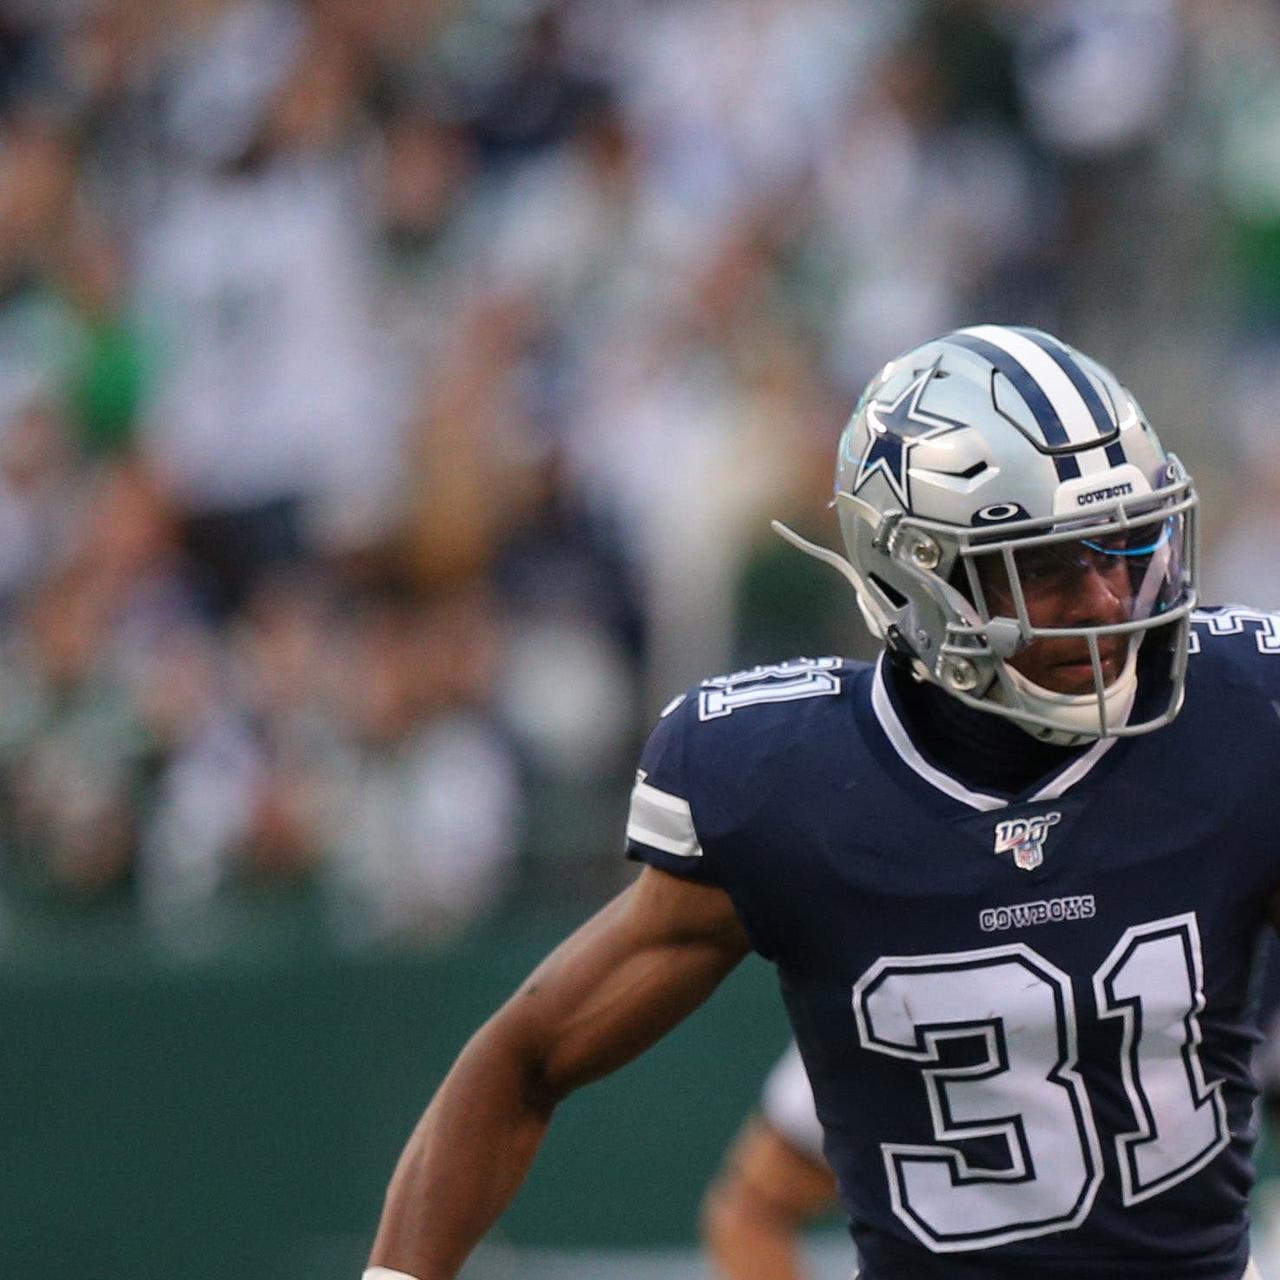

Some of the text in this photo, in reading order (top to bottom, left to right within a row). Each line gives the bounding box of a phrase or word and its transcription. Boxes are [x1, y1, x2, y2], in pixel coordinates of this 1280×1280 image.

[1077, 482, 1134, 507] COWBOYS
[979, 894, 1096, 932] COWBOYS
[851, 911, 1233, 1254] 31
